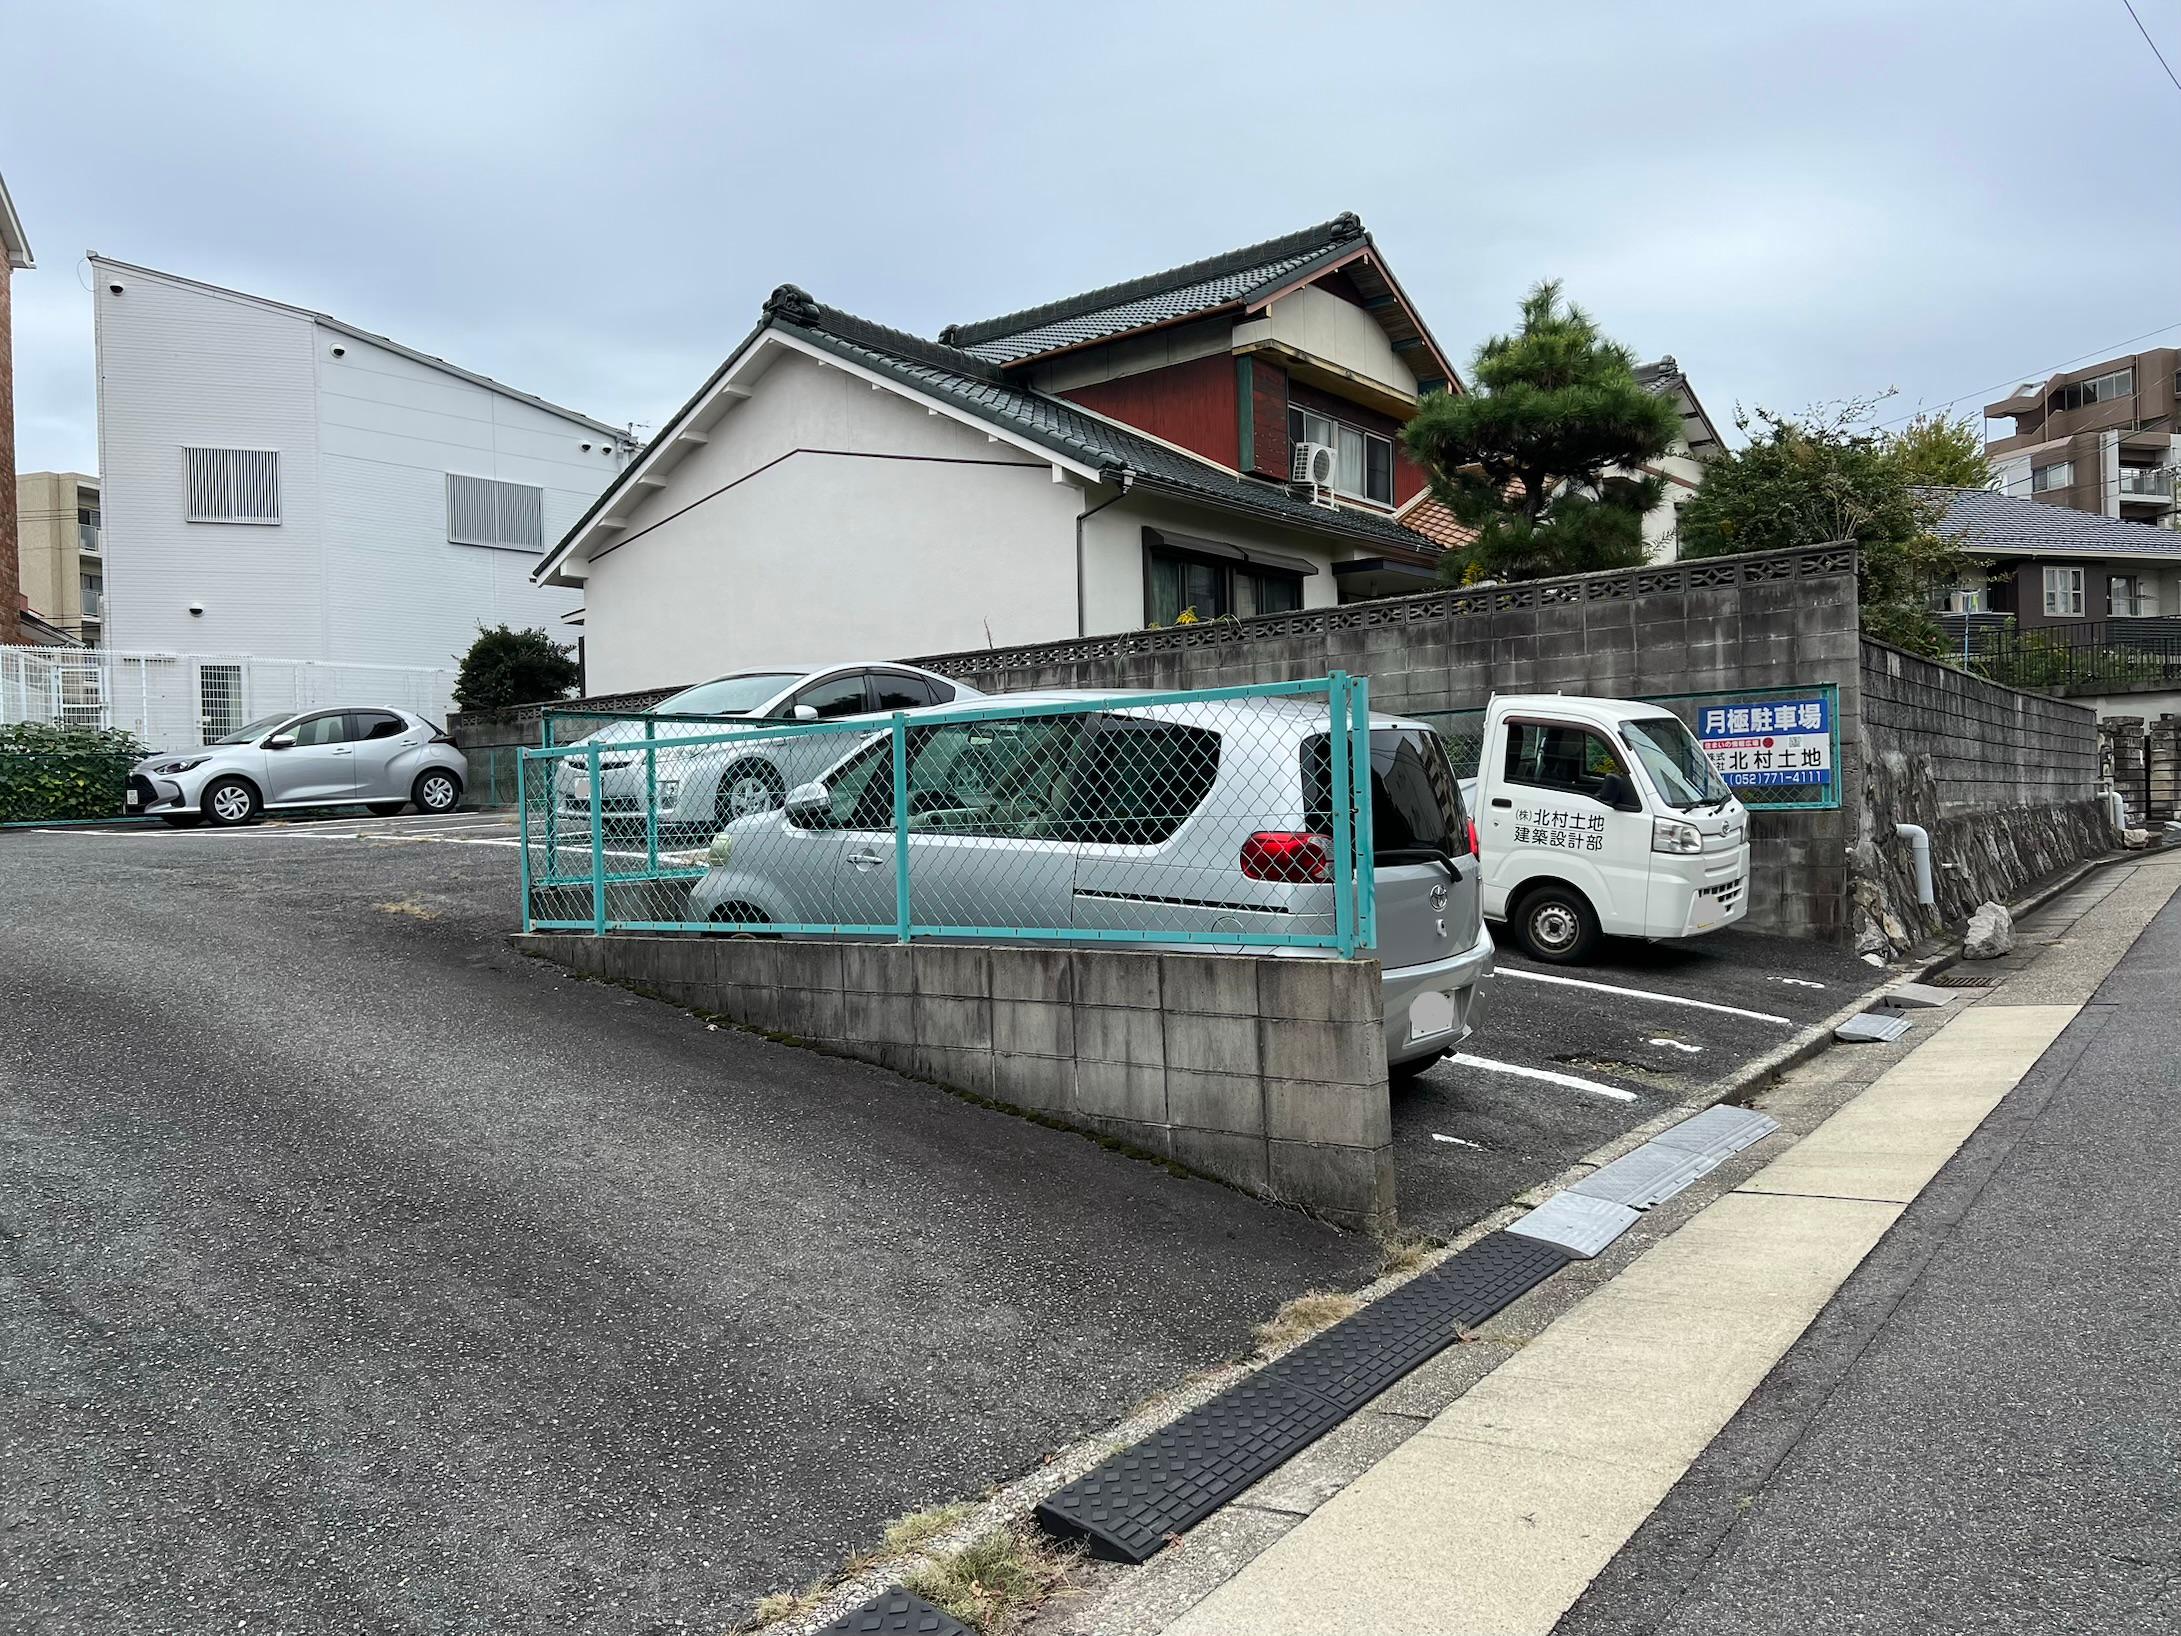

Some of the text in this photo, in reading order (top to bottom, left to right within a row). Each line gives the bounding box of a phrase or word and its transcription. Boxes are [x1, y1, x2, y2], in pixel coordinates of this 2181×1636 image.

[1705, 703, 1822, 735] 月極駐車場
[1729, 747, 1821, 770] 北村土地
[1729, 771, 1822, 785] (052)771-4111
[1513, 826, 1603, 851] 建築設計部
